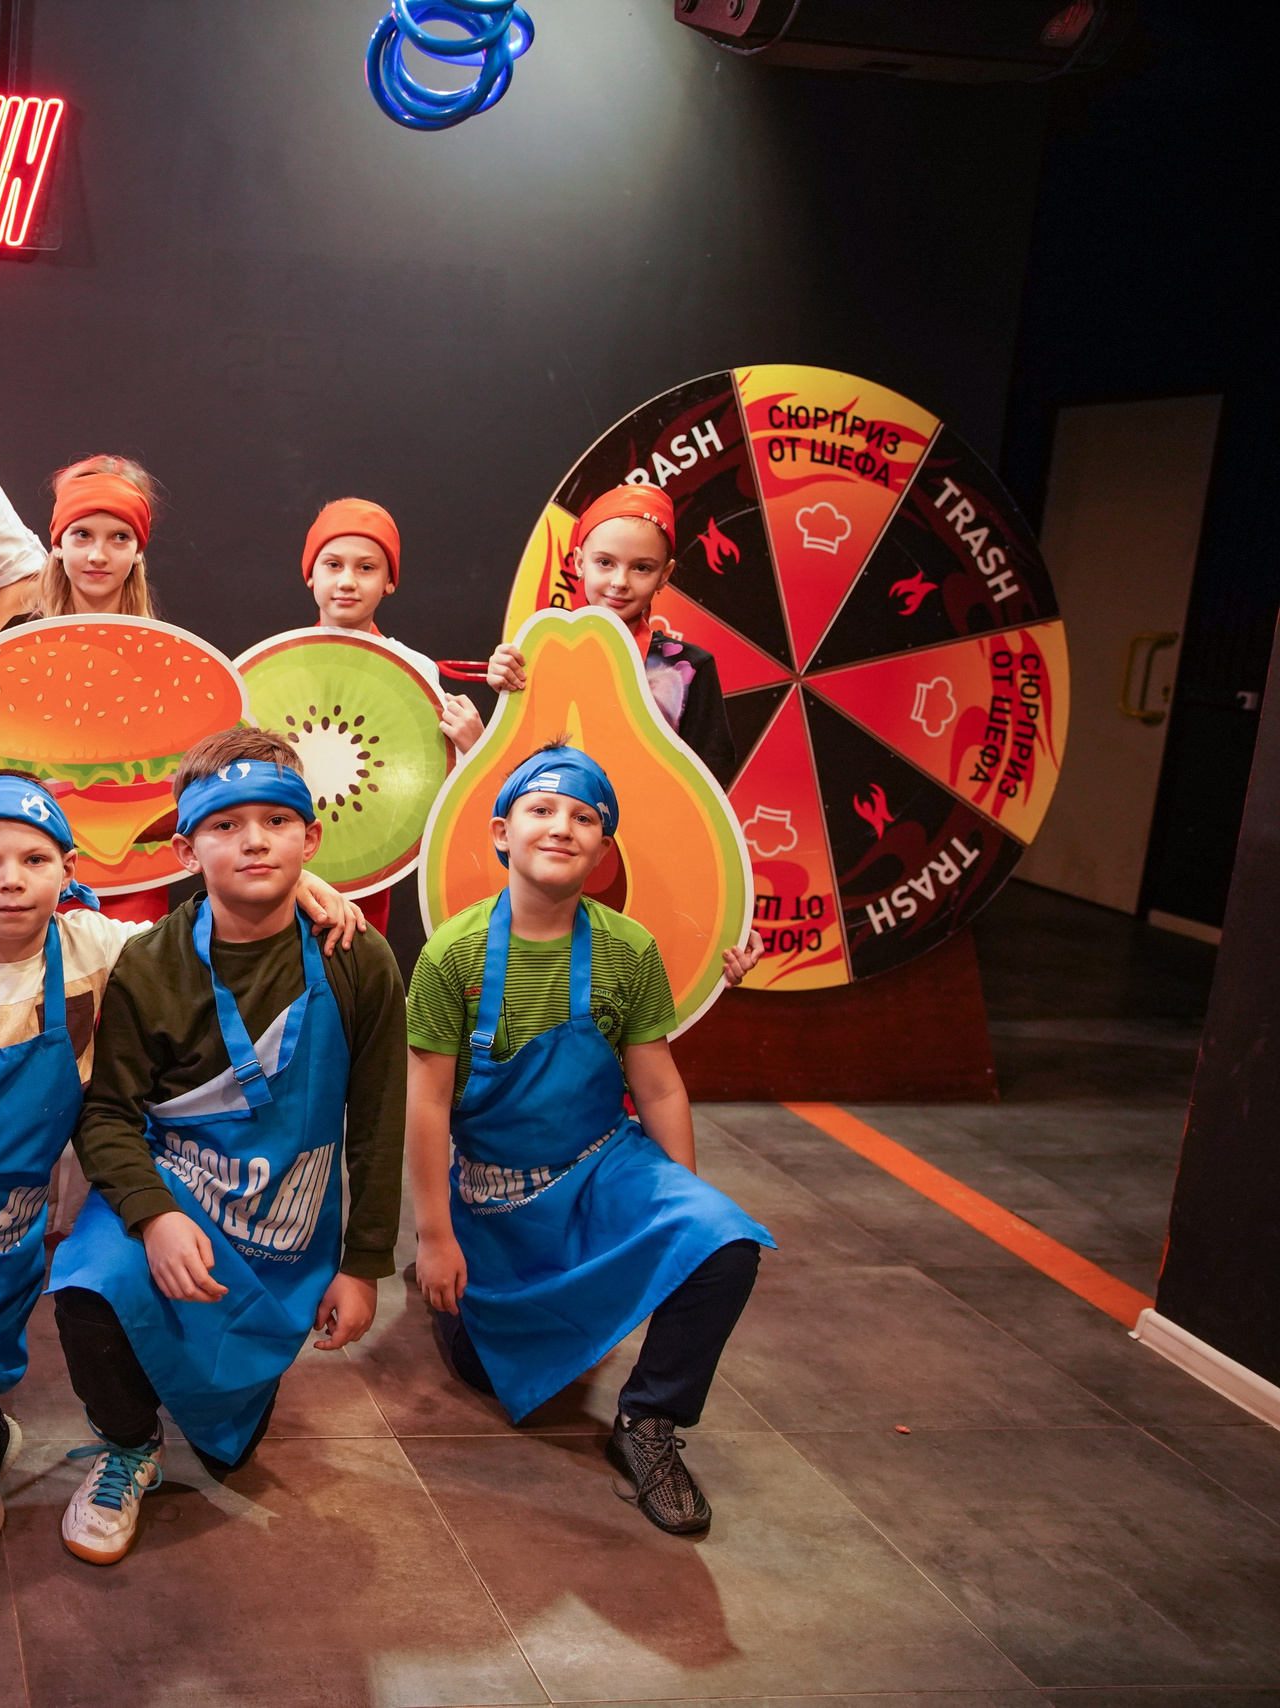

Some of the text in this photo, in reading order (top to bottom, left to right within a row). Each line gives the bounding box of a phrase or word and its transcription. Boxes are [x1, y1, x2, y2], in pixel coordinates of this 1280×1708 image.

[617, 419, 724, 488] RASH
[768, 404, 901, 455] СЮРПРИЗ
[768, 438, 890, 488] ОТ ШЕФА
[933, 477, 1020, 603] TRASH
[969, 651, 1013, 783] ОТ ШЕФА
[998, 653, 1041, 798] СЮРПРИЗ
[790, 895, 824, 920] ОТ
[865, 837, 980, 935] TRASH
[251, 1143, 336, 1252] RUN
